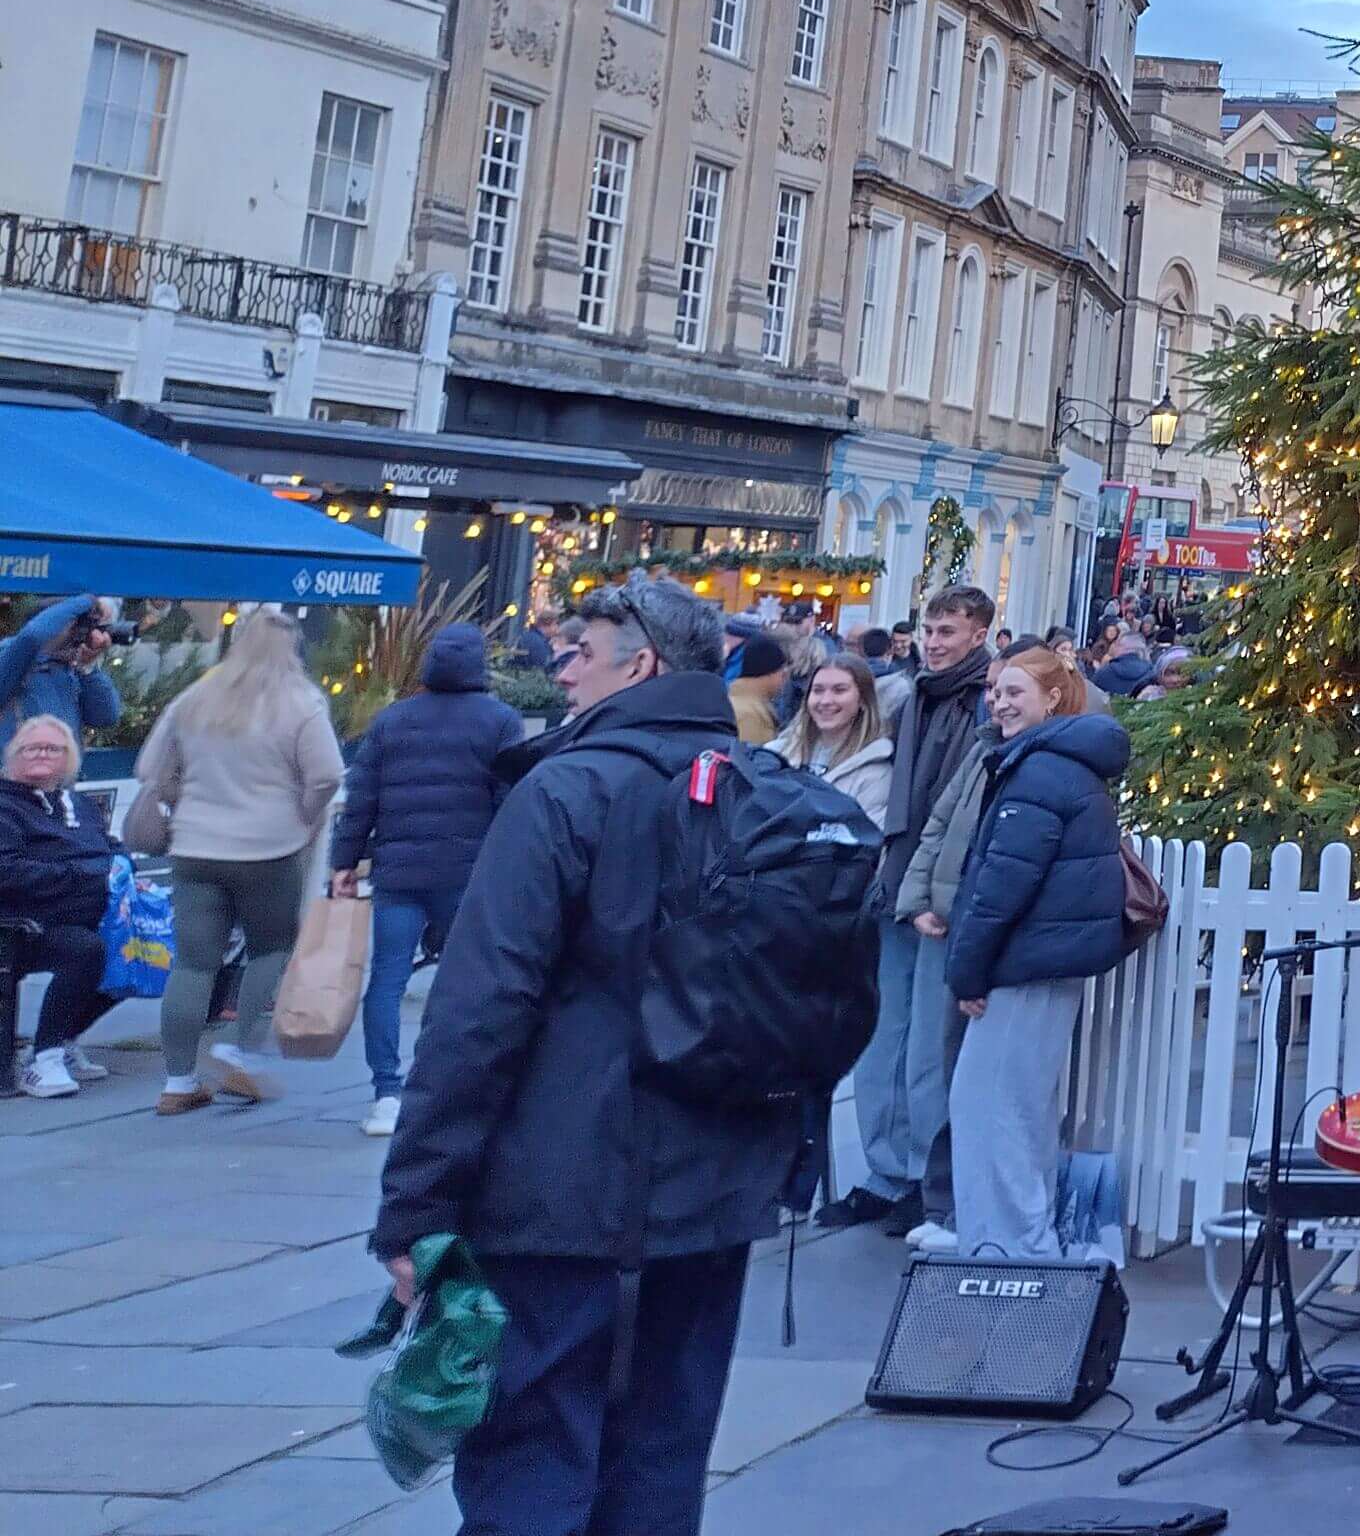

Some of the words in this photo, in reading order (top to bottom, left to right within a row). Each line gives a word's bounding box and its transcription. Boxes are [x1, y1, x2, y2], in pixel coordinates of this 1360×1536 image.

[692, 426, 723, 446] THAT
[727, 432, 744, 448] OF
[748, 435, 793, 456] LONDON
[381, 463, 428, 483] NORDIC
[427, 467, 459, 485] CAFE
[0, 553, 49, 578] rant
[314, 570, 384, 598] SQUARE
[958, 1279, 1043, 1298] CUBE
